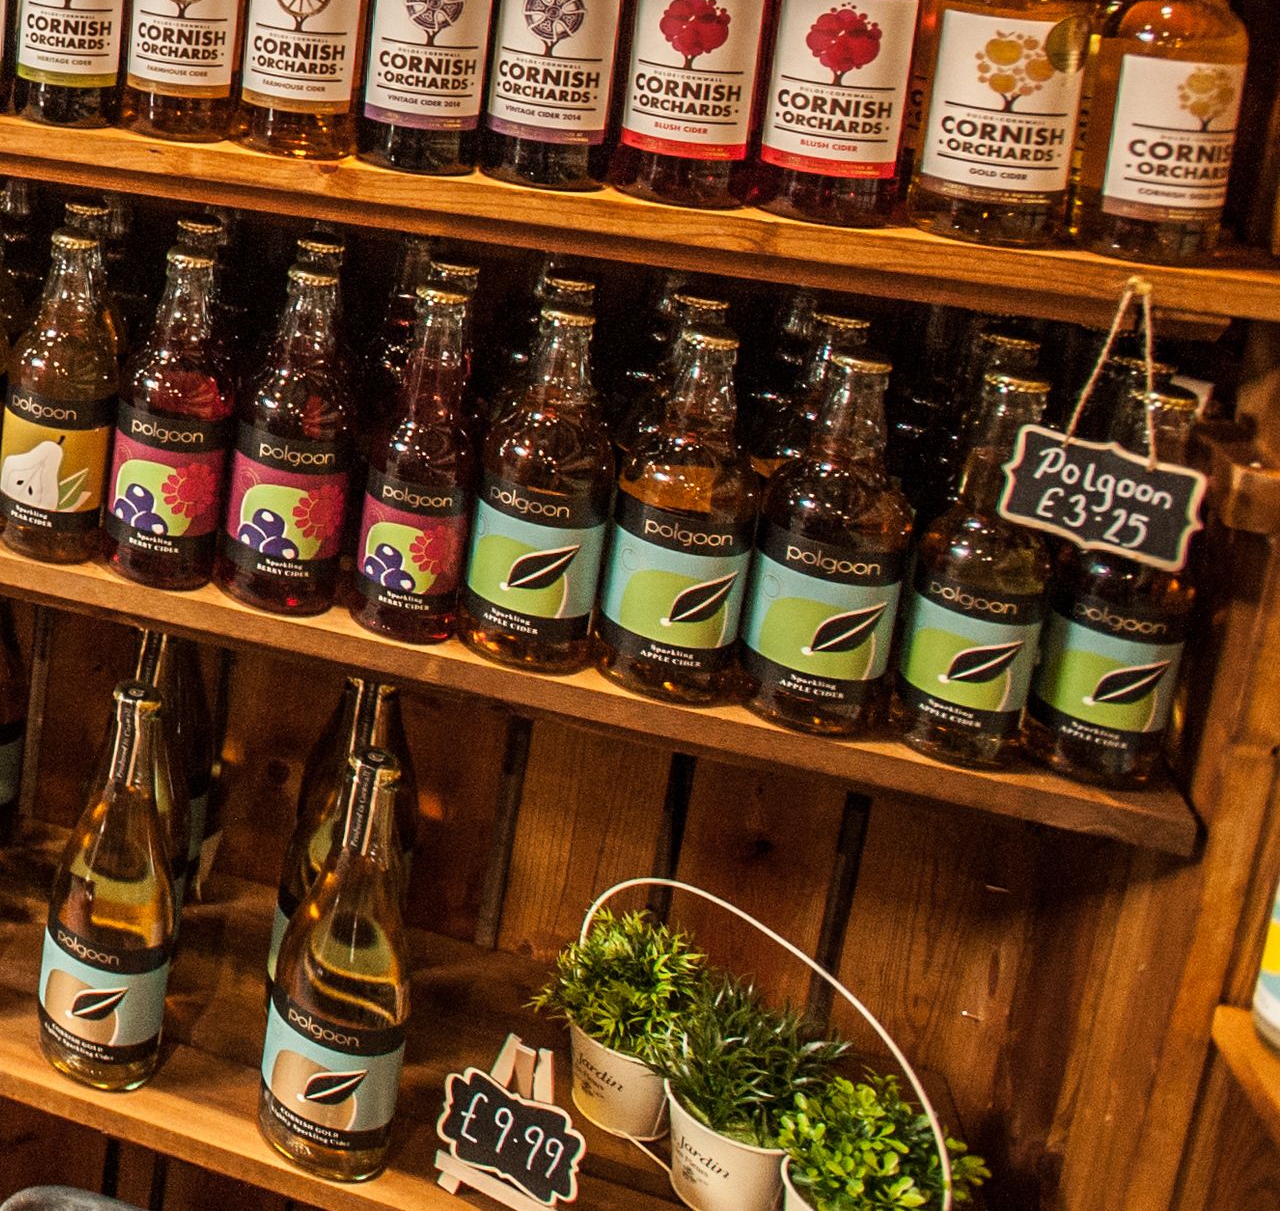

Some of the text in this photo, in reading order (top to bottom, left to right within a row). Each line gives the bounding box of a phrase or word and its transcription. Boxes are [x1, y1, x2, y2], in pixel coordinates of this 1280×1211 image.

[27, 14, 112, 35] CORNISH
[138, 22, 226, 45] CORNISH
[30, 34, 104, 50] ORCHARDS
[141, 43, 218, 60] ORCHARDS
[253, 36, 345, 60] CORNISH
[257, 56, 336, 74] ORCHARDS
[379, 51, 476, 74] CORNISH
[499, 60, 600, 87] CORNISH
[306, 84, 326, 92] CIDER
[383, 70, 468, 89] ORCHARDS
[635, 73, 741, 101] CORNISH
[502, 82, 590, 103] ORCHARDS
[777, 89, 892, 118] CORNISH
[505, 105, 537, 116] VINTAGE
[538, 109, 561, 119] CIDER
[639, 94, 731, 117] ORCHARDS
[654, 122, 708, 134] BLUSH CIDER
[782, 111, 882, 134] ORCHARDS
[941, 116, 1064, 146] CORNISH
[946, 138, 1053, 162] ORCHARDS
[969, 167, 1028, 180] GOLD CIDER
[13, 394, 76, 421] polgoon
[131, 418, 203, 443] polgoon
[259, 443, 335, 467] polgoon
[1033, 448, 1173, 512] Polgoon
[383, 485, 453, 509] polgoon
[491, 486, 570, 520] polgoon
[1037, 488, 1149, 548] £3.25
[645, 518, 733, 547] polgoon
[155, 545, 179, 554] CIDER
[786, 545, 881, 577] polgoon
[930, 582, 1017, 614] polgoon
[640, 650, 701, 668] APPLE CIDER
[650, 644, 694, 659] Sparkling
[57, 931, 119, 965] polgoon
[288, 1008, 359, 1046] polgoon
[460, 1092, 564, 1178] £9.99
